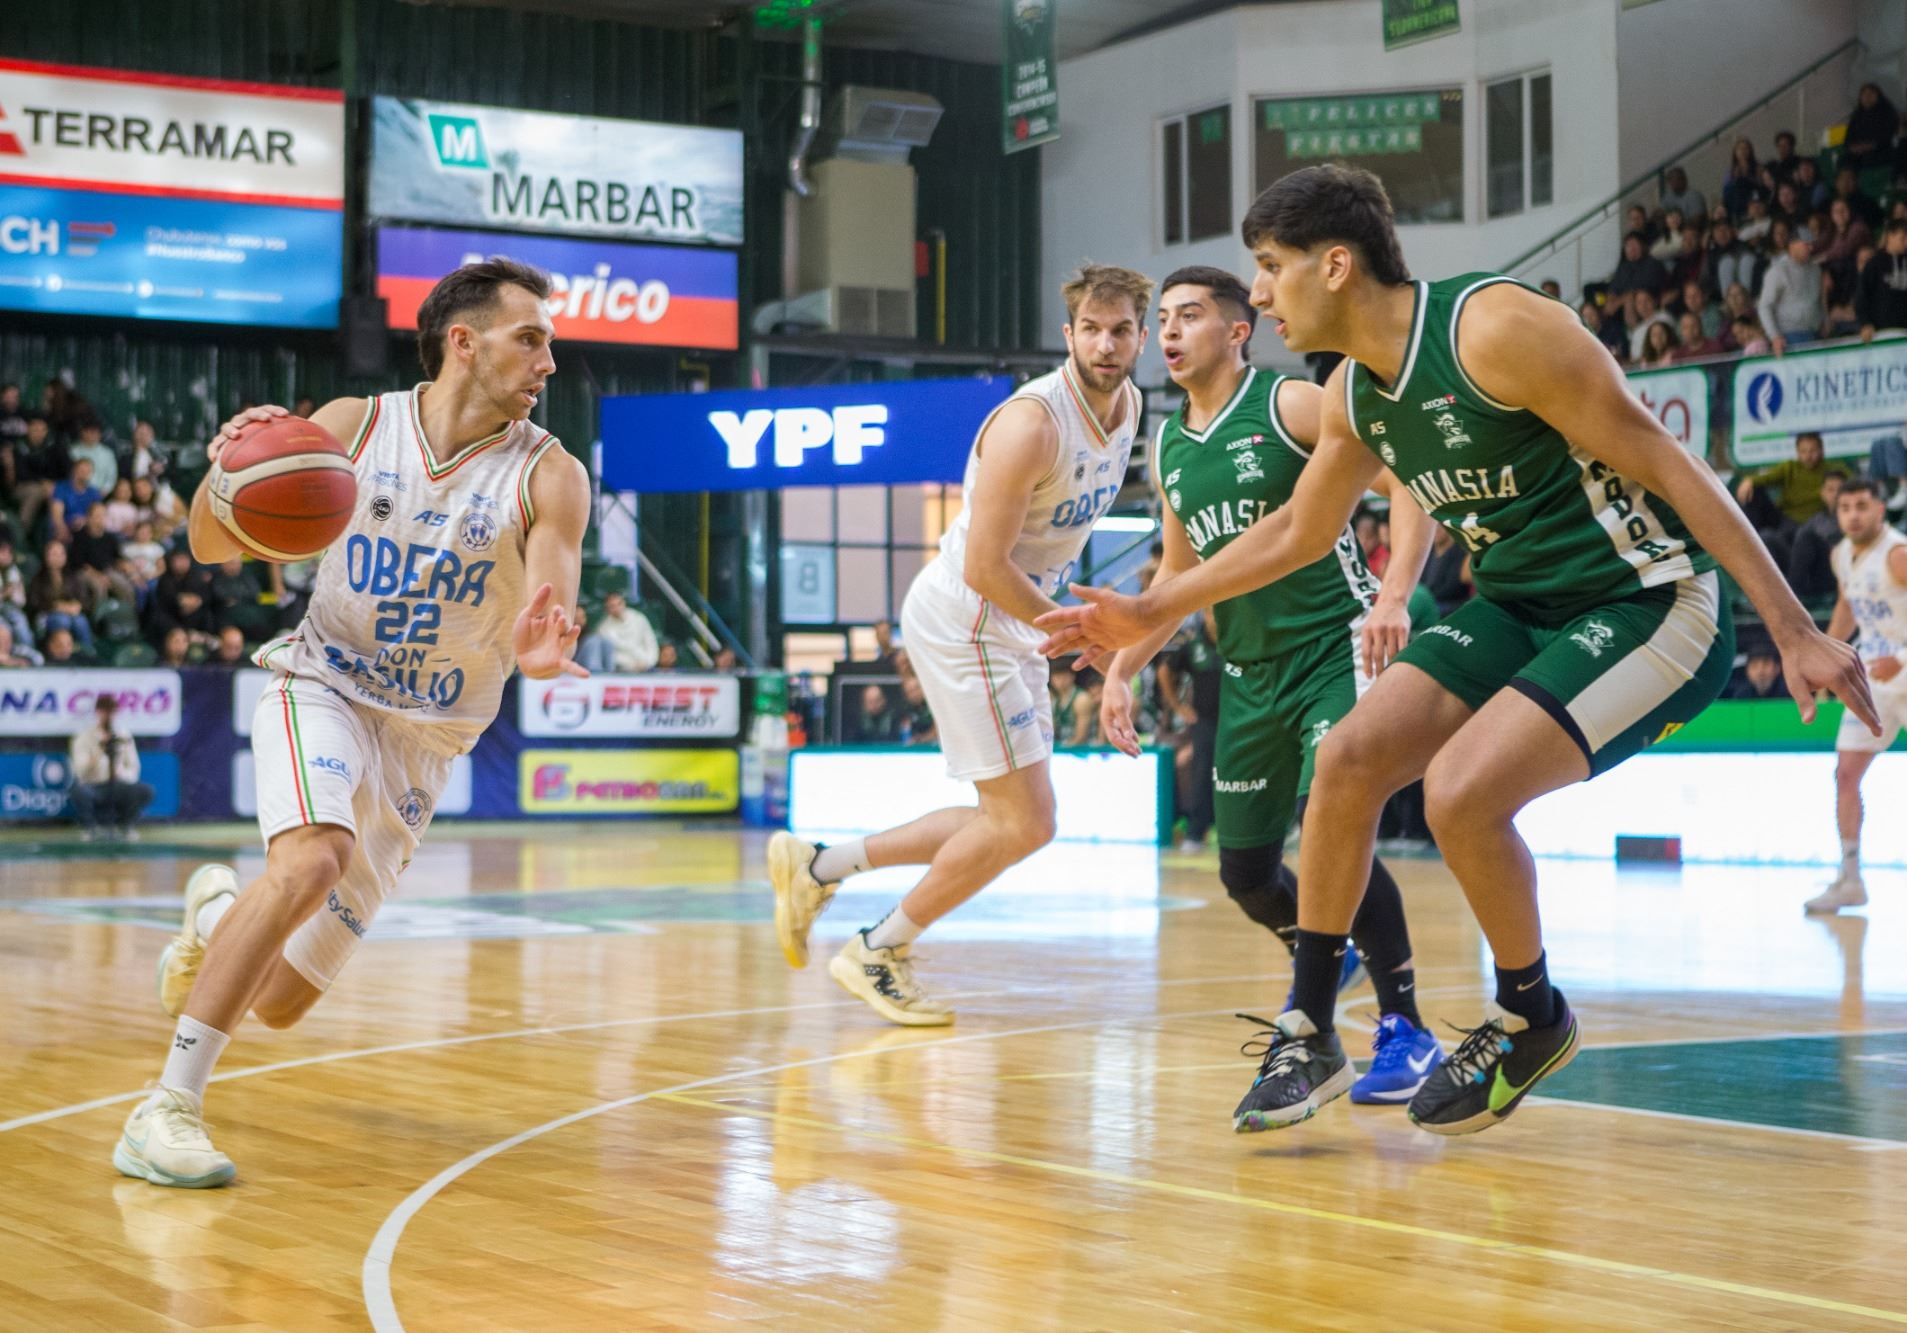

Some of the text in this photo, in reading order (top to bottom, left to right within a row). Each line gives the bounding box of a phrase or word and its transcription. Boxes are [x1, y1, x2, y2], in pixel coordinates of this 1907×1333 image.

[23, 107, 297, 166] TERRAMAR
[490, 171, 697, 230] MARBAR
[709, 404, 888, 468] YPF
[413, 510, 450, 526] AS
[347, 533, 497, 607] OBERA
[375, 601, 442, 645] 22
[373, 647, 427, 668] DON
[354, 682, 393, 708] YERBA
[643, 714, 720, 728] ENERGY
[1215, 778, 1268, 793] MARBAR
